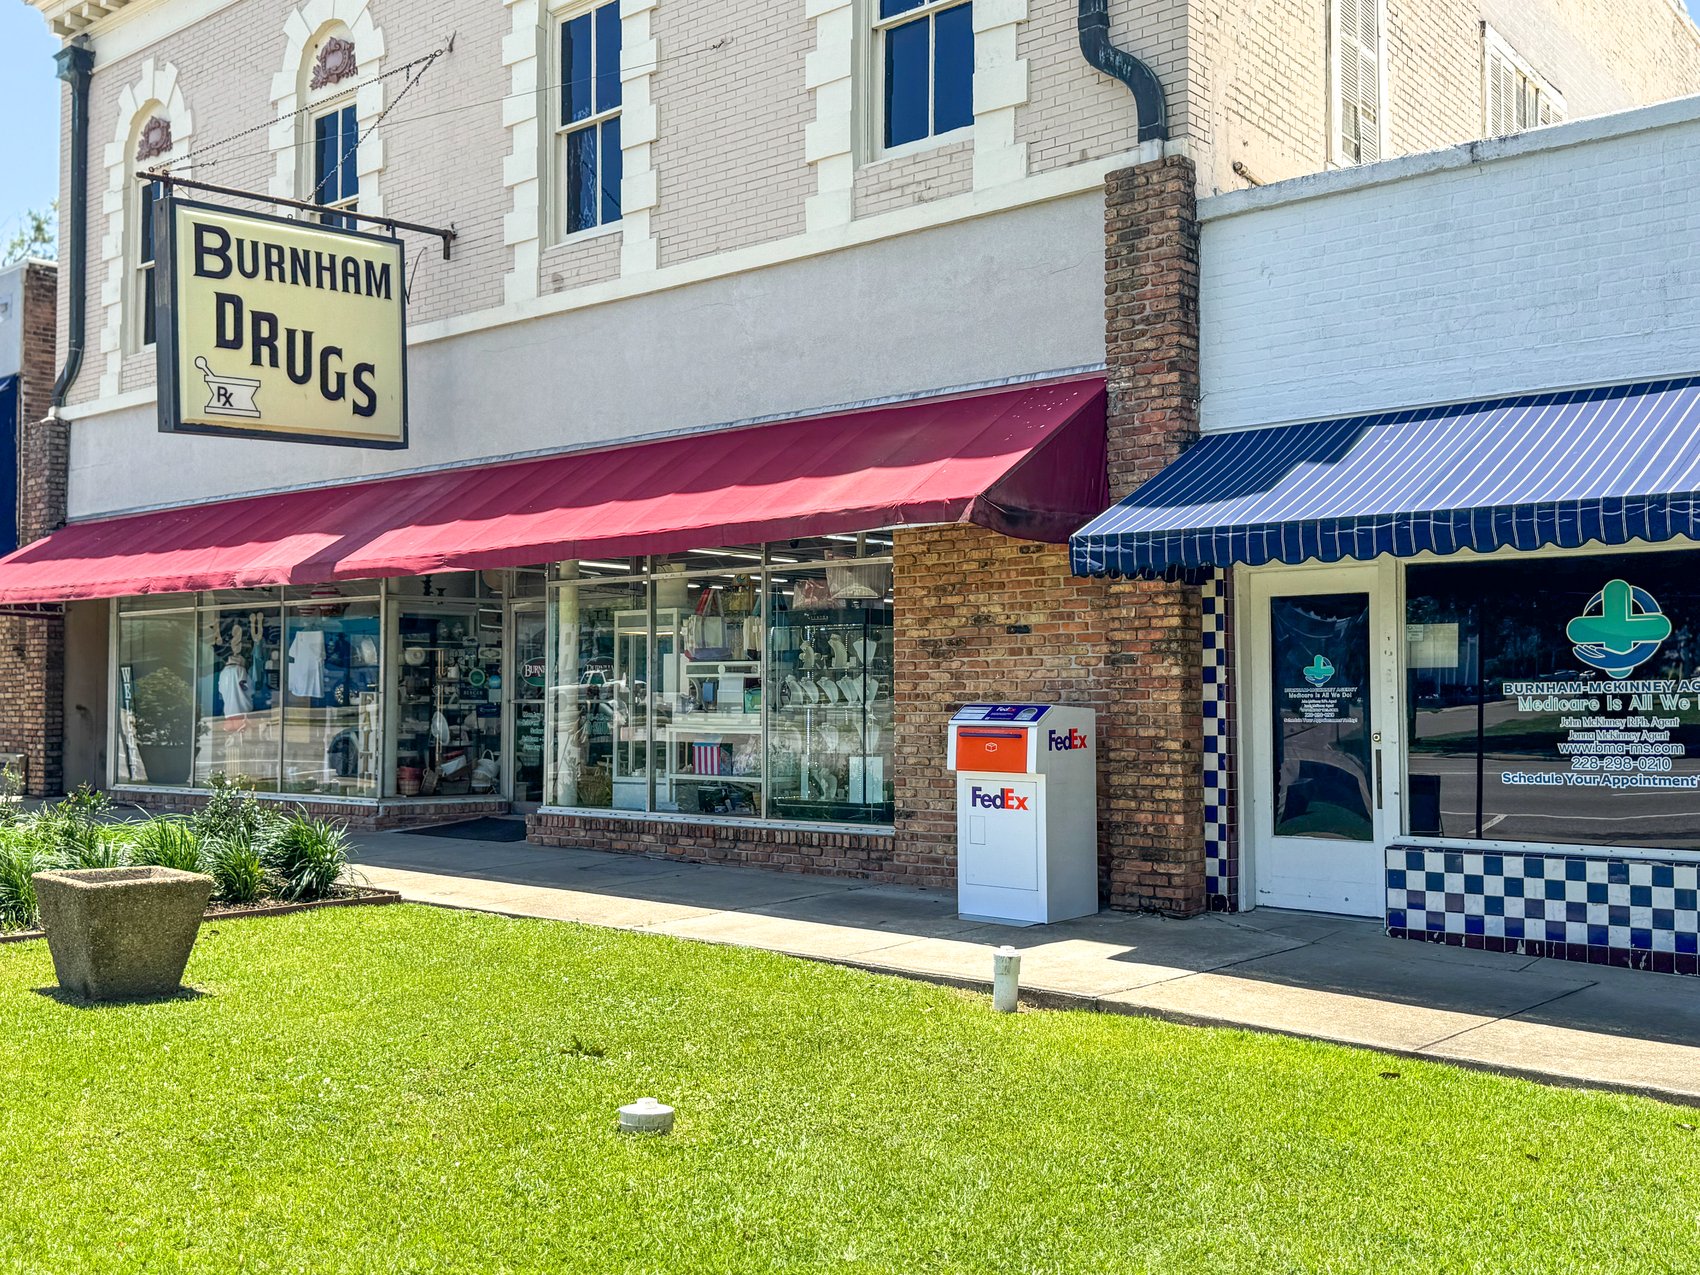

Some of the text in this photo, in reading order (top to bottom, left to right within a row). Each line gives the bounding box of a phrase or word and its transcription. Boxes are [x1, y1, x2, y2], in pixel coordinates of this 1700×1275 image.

[192, 221, 392, 300] BURNHAM
[213, 291, 377, 418] DRUGS
[1503, 680, 1673, 695] BURNHAM-MCKINNEY
[1518, 695, 1600, 711] Medicare
[1606, 694, 1622, 711] Is
[1628, 694, 1653, 710] All
[1659, 694, 1691, 710] We
[1560, 716, 1581, 727] John
[1582, 716, 1626, 729] McKinney
[1651, 716, 1680, 729] Agent
[1048, 728, 1088, 751] FedEx
[1596, 730, 1641, 743] McKinney
[1641, 730, 1670, 743] Agent
[1557, 741, 1686, 755] www.bma-ms.com
[1571, 756, 1672, 771] 228-298-0210
[1501, 771, 1563, 785] Schedule
[1563, 773, 1600, 786] Your
[1600, 773, 1698, 788] Appointment
[971, 786, 1029, 811] FedEx
